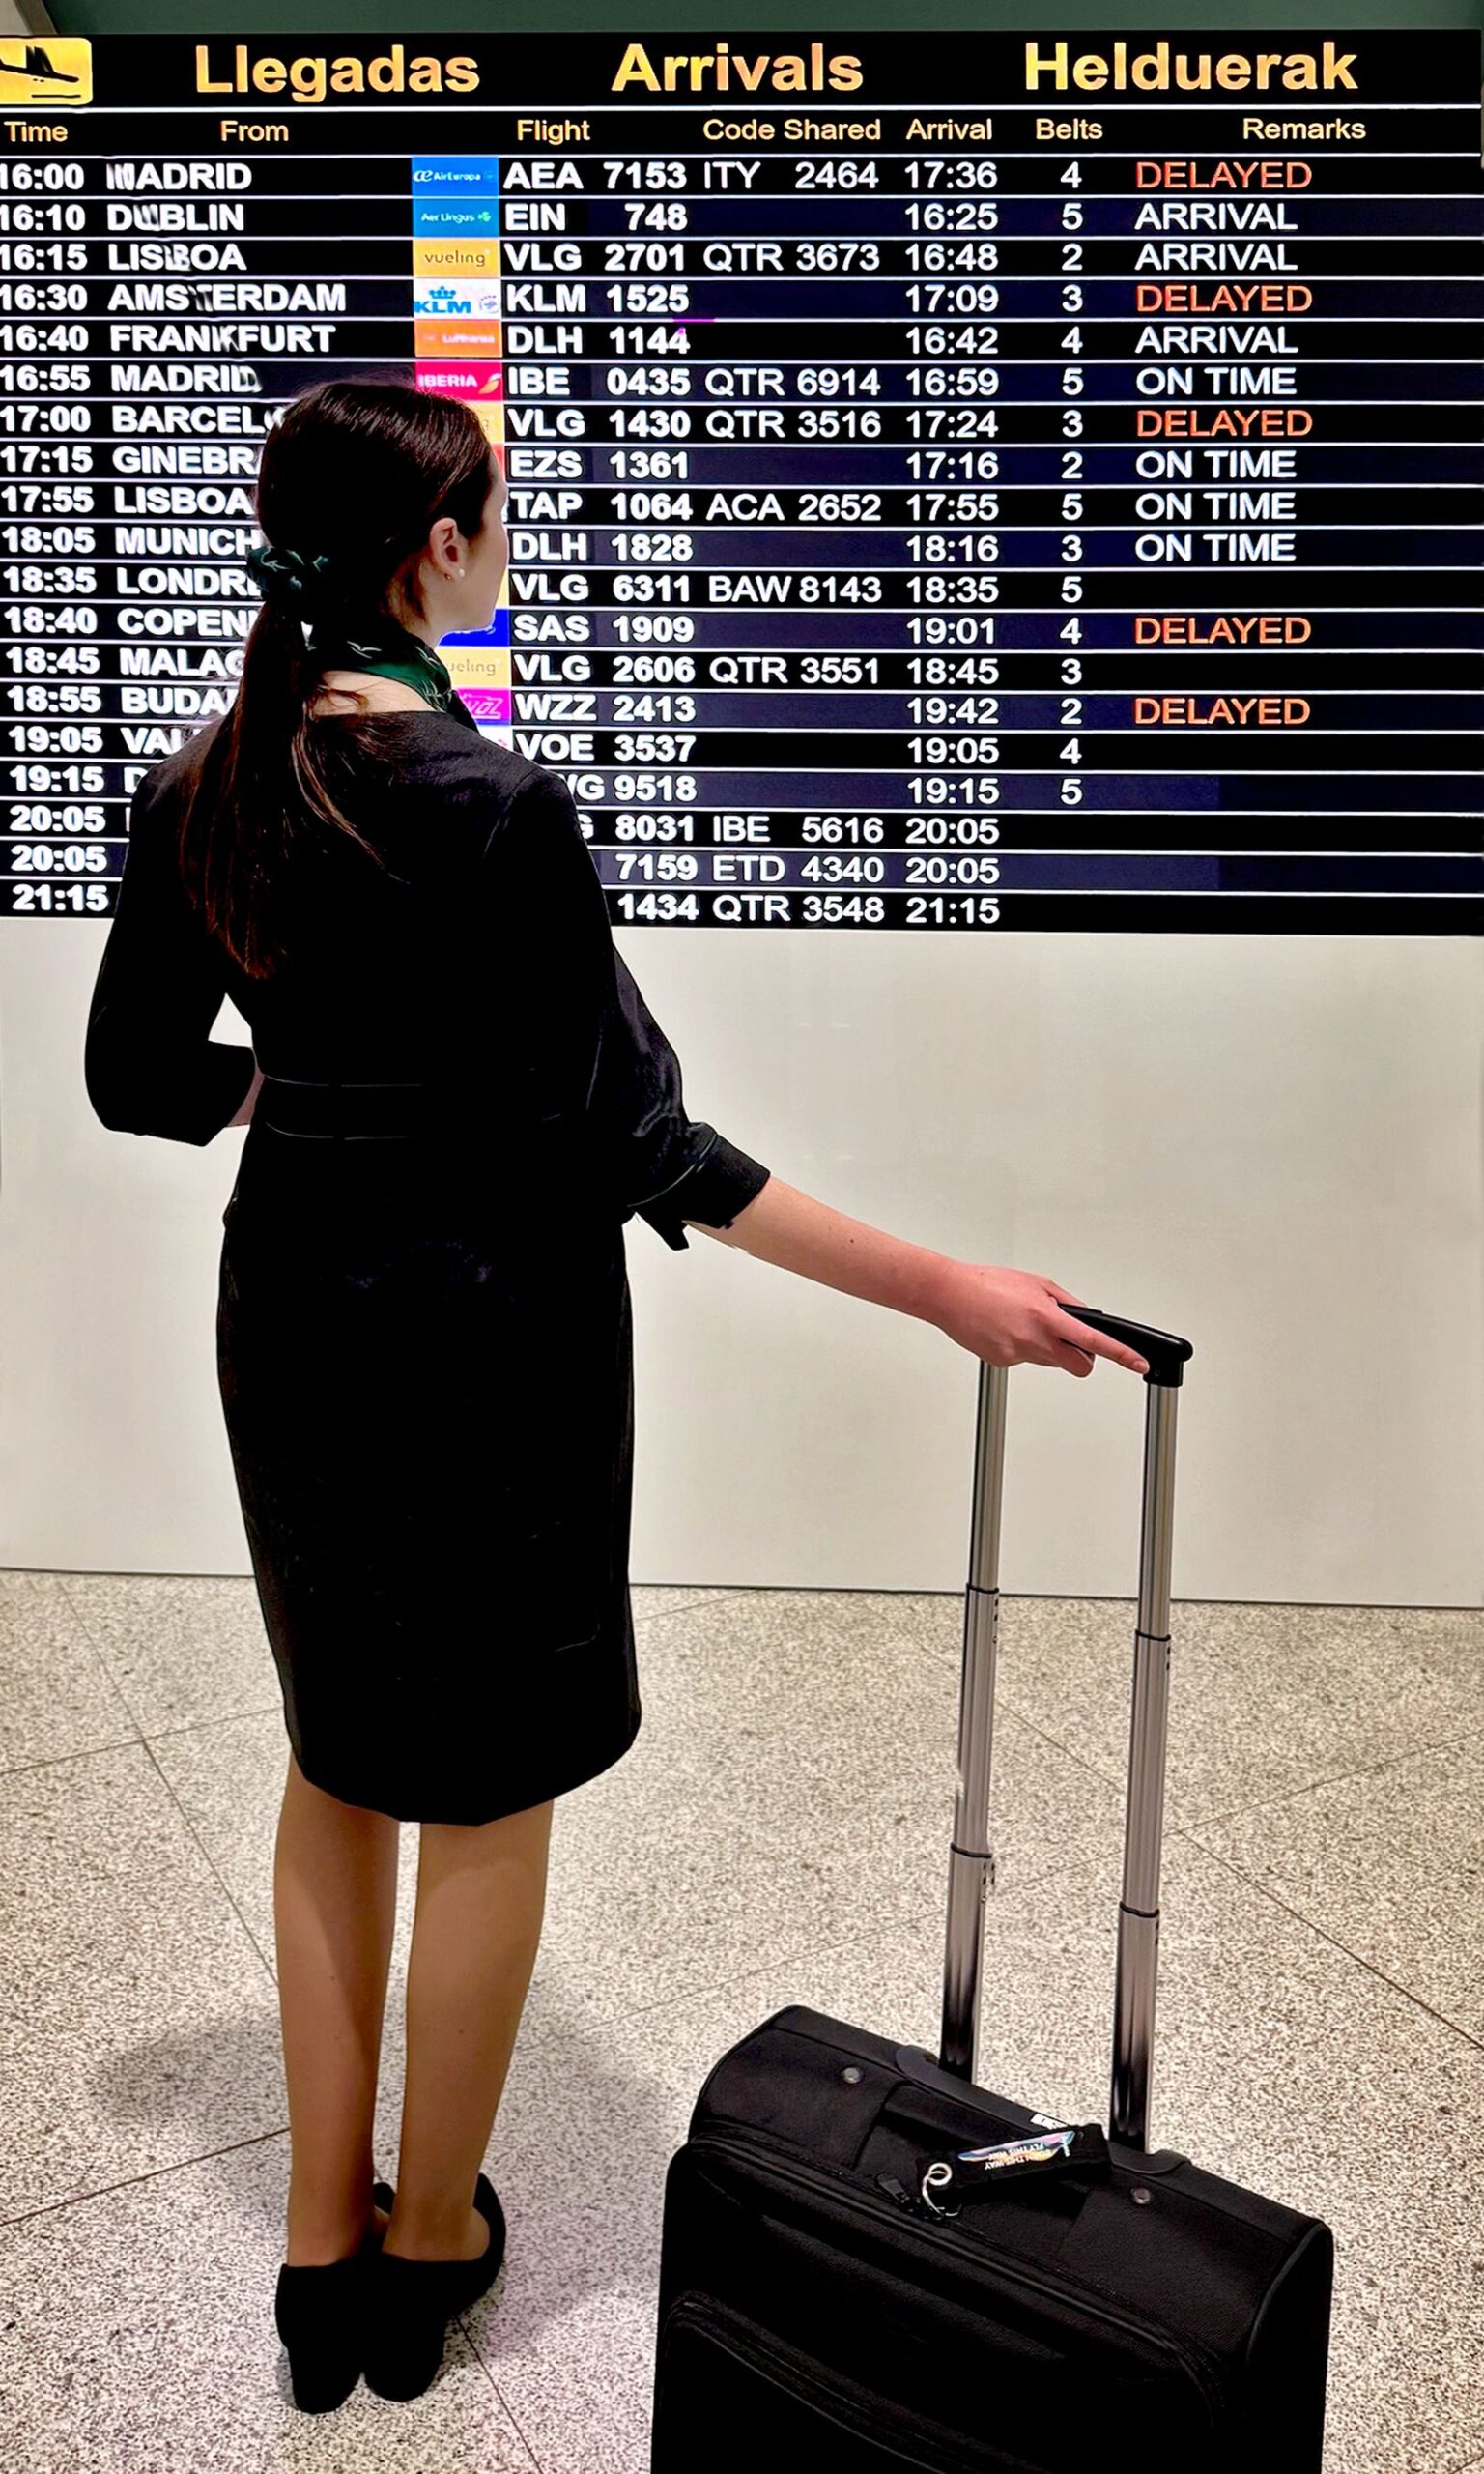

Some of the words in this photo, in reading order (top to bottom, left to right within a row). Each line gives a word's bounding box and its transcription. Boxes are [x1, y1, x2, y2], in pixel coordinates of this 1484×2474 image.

[196, 44, 479, 102] Llegadas
[612, 43, 863, 91] Arrivals
[1026, 42, 1358, 90] Helduerak
[4, 121, 68, 142] Time
[221, 121, 288, 141] From
[518, 120, 590, 145] Flight
[703, 119, 775, 140] Code
[785, 119, 880, 140] Shared
[906, 119, 992, 139] Arrival
[1037, 118, 1102, 139] Belts
[1243, 118, 1366, 139] Remarks
[0, 163, 84, 189] 16:00
[106, 163, 251, 190] MADRID
[503, 162, 584, 188] AEA
[604, 162, 687, 188] 7153
[704, 161, 760, 188] ITY
[795, 161, 879, 188] 2464
[906, 162, 998, 188] 17:36
[1061, 161, 1082, 188] 4
[1137, 162, 1312, 187] DELAYED
[0, 204, 85, 230] 16:10
[107, 204, 244, 231] DUBLIN
[505, 203, 565, 230] EIN
[625, 203, 687, 230] 748
[906, 203, 998, 230] 16:25
[1062, 203, 1083, 230] 5
[1135, 203, 1298, 229] ARRIVAL
[421, 213, 439, 222] Aer
[441, 213, 475, 223] Lingus
[0, 244, 87, 270] 16:15
[109, 244, 246, 271] LISBOA
[504, 244, 581, 271] VLG
[605, 244, 684, 271] 2701
[703, 244, 784, 272] QTR
[797, 244, 879, 271] 3673
[906, 244, 998, 271] 16:48
[1062, 244, 1082, 270] 2
[1135, 244, 1298, 270] ARRIVAL
[425, 250, 485, 267] vueling
[0, 284, 87, 310] 16:30
[108, 284, 346, 311] AMSTERDAM
[507, 285, 585, 312] KLM
[607, 285, 689, 312] 1525
[906, 285, 998, 312] 17:09
[1063, 285, 1082, 311] 3
[1137, 285, 1312, 311] DELAYED
[414, 301, 471, 313] KLM
[0, 325, 88, 351] 16:40
[110, 325, 336, 352] FRANKFURT
[508, 327, 582, 354] DLH
[610, 327, 690, 354] 1144
[906, 327, 998, 354] 16:42
[1061, 327, 1083, 354] 4
[1135, 326, 1298, 353] ARRIVAL
[0, 365, 90, 391] 16:55
[111, 365, 262, 392] MADRID
[508, 367, 570, 395] IBE
[607, 367, 690, 395] 0435
[705, 368, 785, 396] QTR
[798, 368, 880, 395] 6914
[906, 368, 998, 395] 16:59
[1063, 368, 1083, 395] 5
[1136, 367, 1192, 394] ON
[1204, 367, 1297, 394] TIME
[417, 374, 477, 388] IBERIA
[0, 406, 91, 432] 17:00
[508, 410, 585, 437] VLG
[610, 410, 691, 437] 1430
[706, 410, 785, 438] QTR
[798, 411, 881, 438] 3516
[906, 410, 998, 438] 17:24
[1063, 410, 1083, 437] 3
[1137, 410, 1312, 436] DELAYED
[0, 446, 93, 473] 17:15
[510, 451, 582, 478] EZS
[610, 451, 688, 478] 1361
[906, 452, 998, 479] 17:16
[1062, 451, 1082, 478] 2
[1136, 450, 1192, 478] ON
[1204, 450, 1297, 478] TIME
[1, 486, 94, 512] 17:55
[114, 486, 255, 515] LISBOA
[509, 493, 583, 520] TAP
[611, 493, 693, 520] 1064
[706, 494, 785, 520] ACA
[799, 494, 881, 521] 2652
[906, 494, 998, 521] 17:55
[1062, 494, 1083, 520] 5
[1136, 493, 1191, 520] ON
[1203, 492, 1296, 519] TIME
[2, 526, 95, 553] 18:05
[115, 527, 262, 556] MUNICH
[512, 534, 586, 561] DLH
[612, 534, 693, 561] 1828
[906, 535, 998, 561] 18:16
[1062, 535, 1082, 561] 3
[1135, 534, 1191, 561] ON
[1203, 534, 1296, 561] TIME
[4, 566, 97, 593] 18:35
[512, 575, 588, 602] VLG
[614, 575, 690, 602] 6311
[709, 576, 792, 602] BAW
[800, 576, 881, 602] 8143
[906, 577, 998, 603] 18:35
[1062, 576, 1082, 602] 5
[4, 606, 97, 634] 18:40
[514, 616, 589, 642] SAS
[614, 616, 694, 642] 1909
[906, 618, 993, 644] 19:01
[1060, 618, 1082, 644] 4
[1135, 618, 1311, 644] DELAYED
[6, 647, 100, 674] 18:45
[514, 656, 590, 682] VLG
[613, 656, 695, 682] 2606
[710, 657, 788, 683] QTR
[801, 657, 877, 684] 3551
[906, 658, 998, 684] 18:45
[1062, 658, 1081, 684] 3
[7, 685, 101, 713] 18:55
[515, 695, 596, 721] WZZ
[614, 695, 696, 721] 2413
[906, 698, 998, 724] 19:42
[1061, 698, 1081, 724] 2
[1135, 698, 1310, 724] DELAYED
[9, 726, 102, 753] 19:05
[518, 735, 594, 762] VOE
[614, 735, 696, 762] 3537
[906, 737, 998, 763] 19:05
[1060, 738, 1082, 764] 4
[10, 765, 104, 792] 19:15
[614, 775, 697, 801] 9518
[906, 778, 998, 804] 19:15
[1061, 779, 1082, 804] 5
[10, 805, 105, 832] 20:05
[615, 815, 694, 841] 8031
[714, 816, 770, 842] IBE
[802, 817, 883, 843] 5616
[906, 818, 998, 844] 20:05
[11, 845, 106, 872] 20:05
[615, 853, 697, 880] 7159
[713, 855, 785, 881] ETD
[801, 856, 884, 882] 4340
[906, 857, 998, 884] 20:05
[13, 884, 108, 911] 21:15
[617, 894, 699, 920] 1434
[713, 895, 790, 921] QTR
[803, 896, 884, 922] 3548
[906, 897, 998, 923] 21:15
